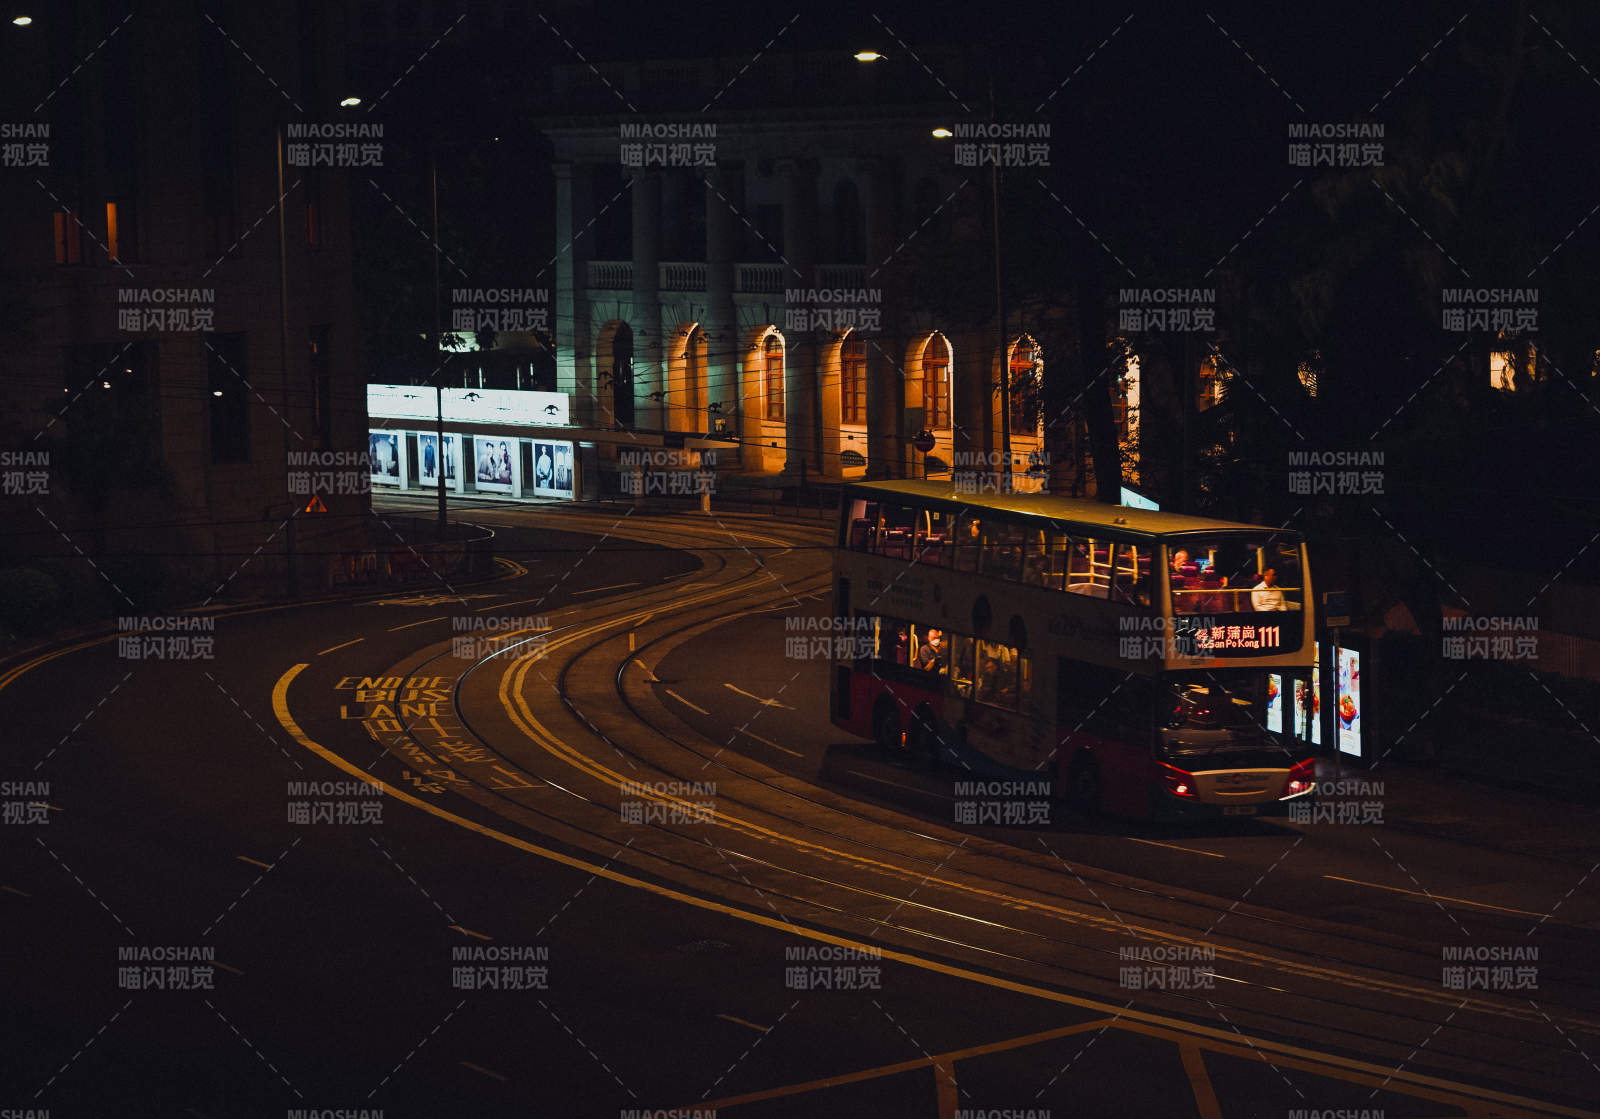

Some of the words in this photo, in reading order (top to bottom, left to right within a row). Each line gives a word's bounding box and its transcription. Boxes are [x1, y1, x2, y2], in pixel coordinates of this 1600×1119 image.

[1209, 639, 1225, 649] San
[1226, 639, 1237, 648] Po
[1238, 639, 1260, 649] Kong
[1258, 626, 1281, 648] 111
[355, 688, 452, 703] BUS
[339, 702, 454, 720] LANE
